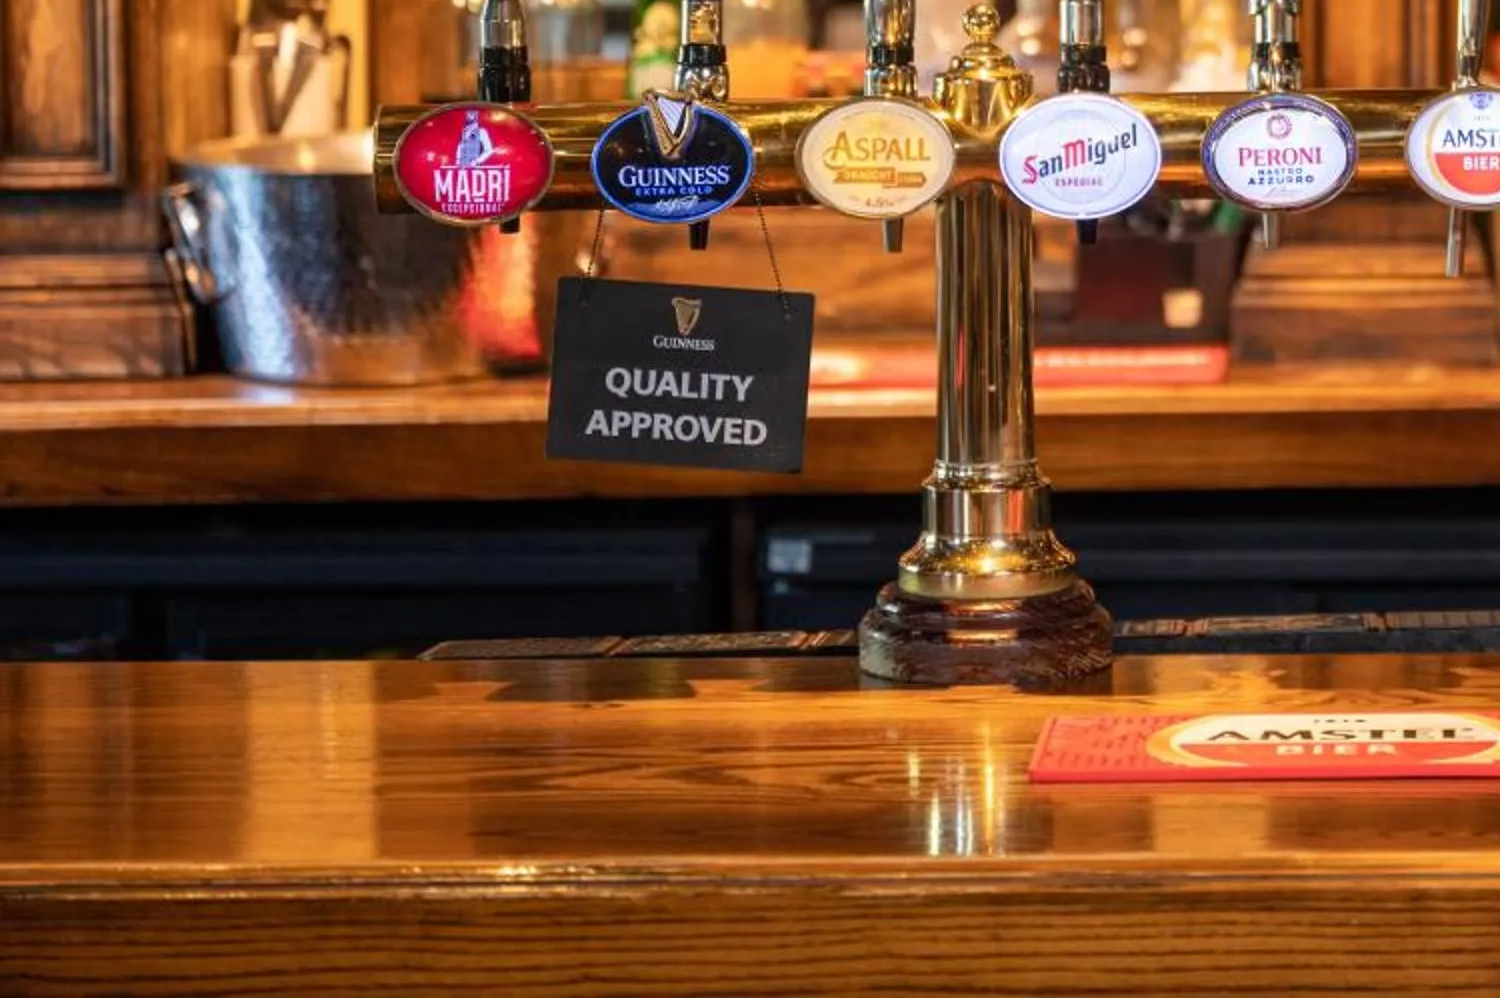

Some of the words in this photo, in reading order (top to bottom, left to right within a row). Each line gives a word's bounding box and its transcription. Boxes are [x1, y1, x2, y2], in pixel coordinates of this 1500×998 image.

[822, 130, 931, 165] ASPALL
[1238, 147, 1323, 167] PERONI
[617, 165, 731, 187] GUINNESS
[1257, 167, 1304, 176] NASTRO
[1247, 175, 1315, 185] AZZURRO
[635, 187, 675, 196] EXTRA
[680, 185, 713, 195] COLD
[653, 335, 716, 351] GUINNESS
[605, 367, 755, 402] QUALITY
[584, 409, 768, 446] APPROVED
[1207, 727, 1475, 742] AMSTEL
[1276, 743, 1399, 757] BIER
